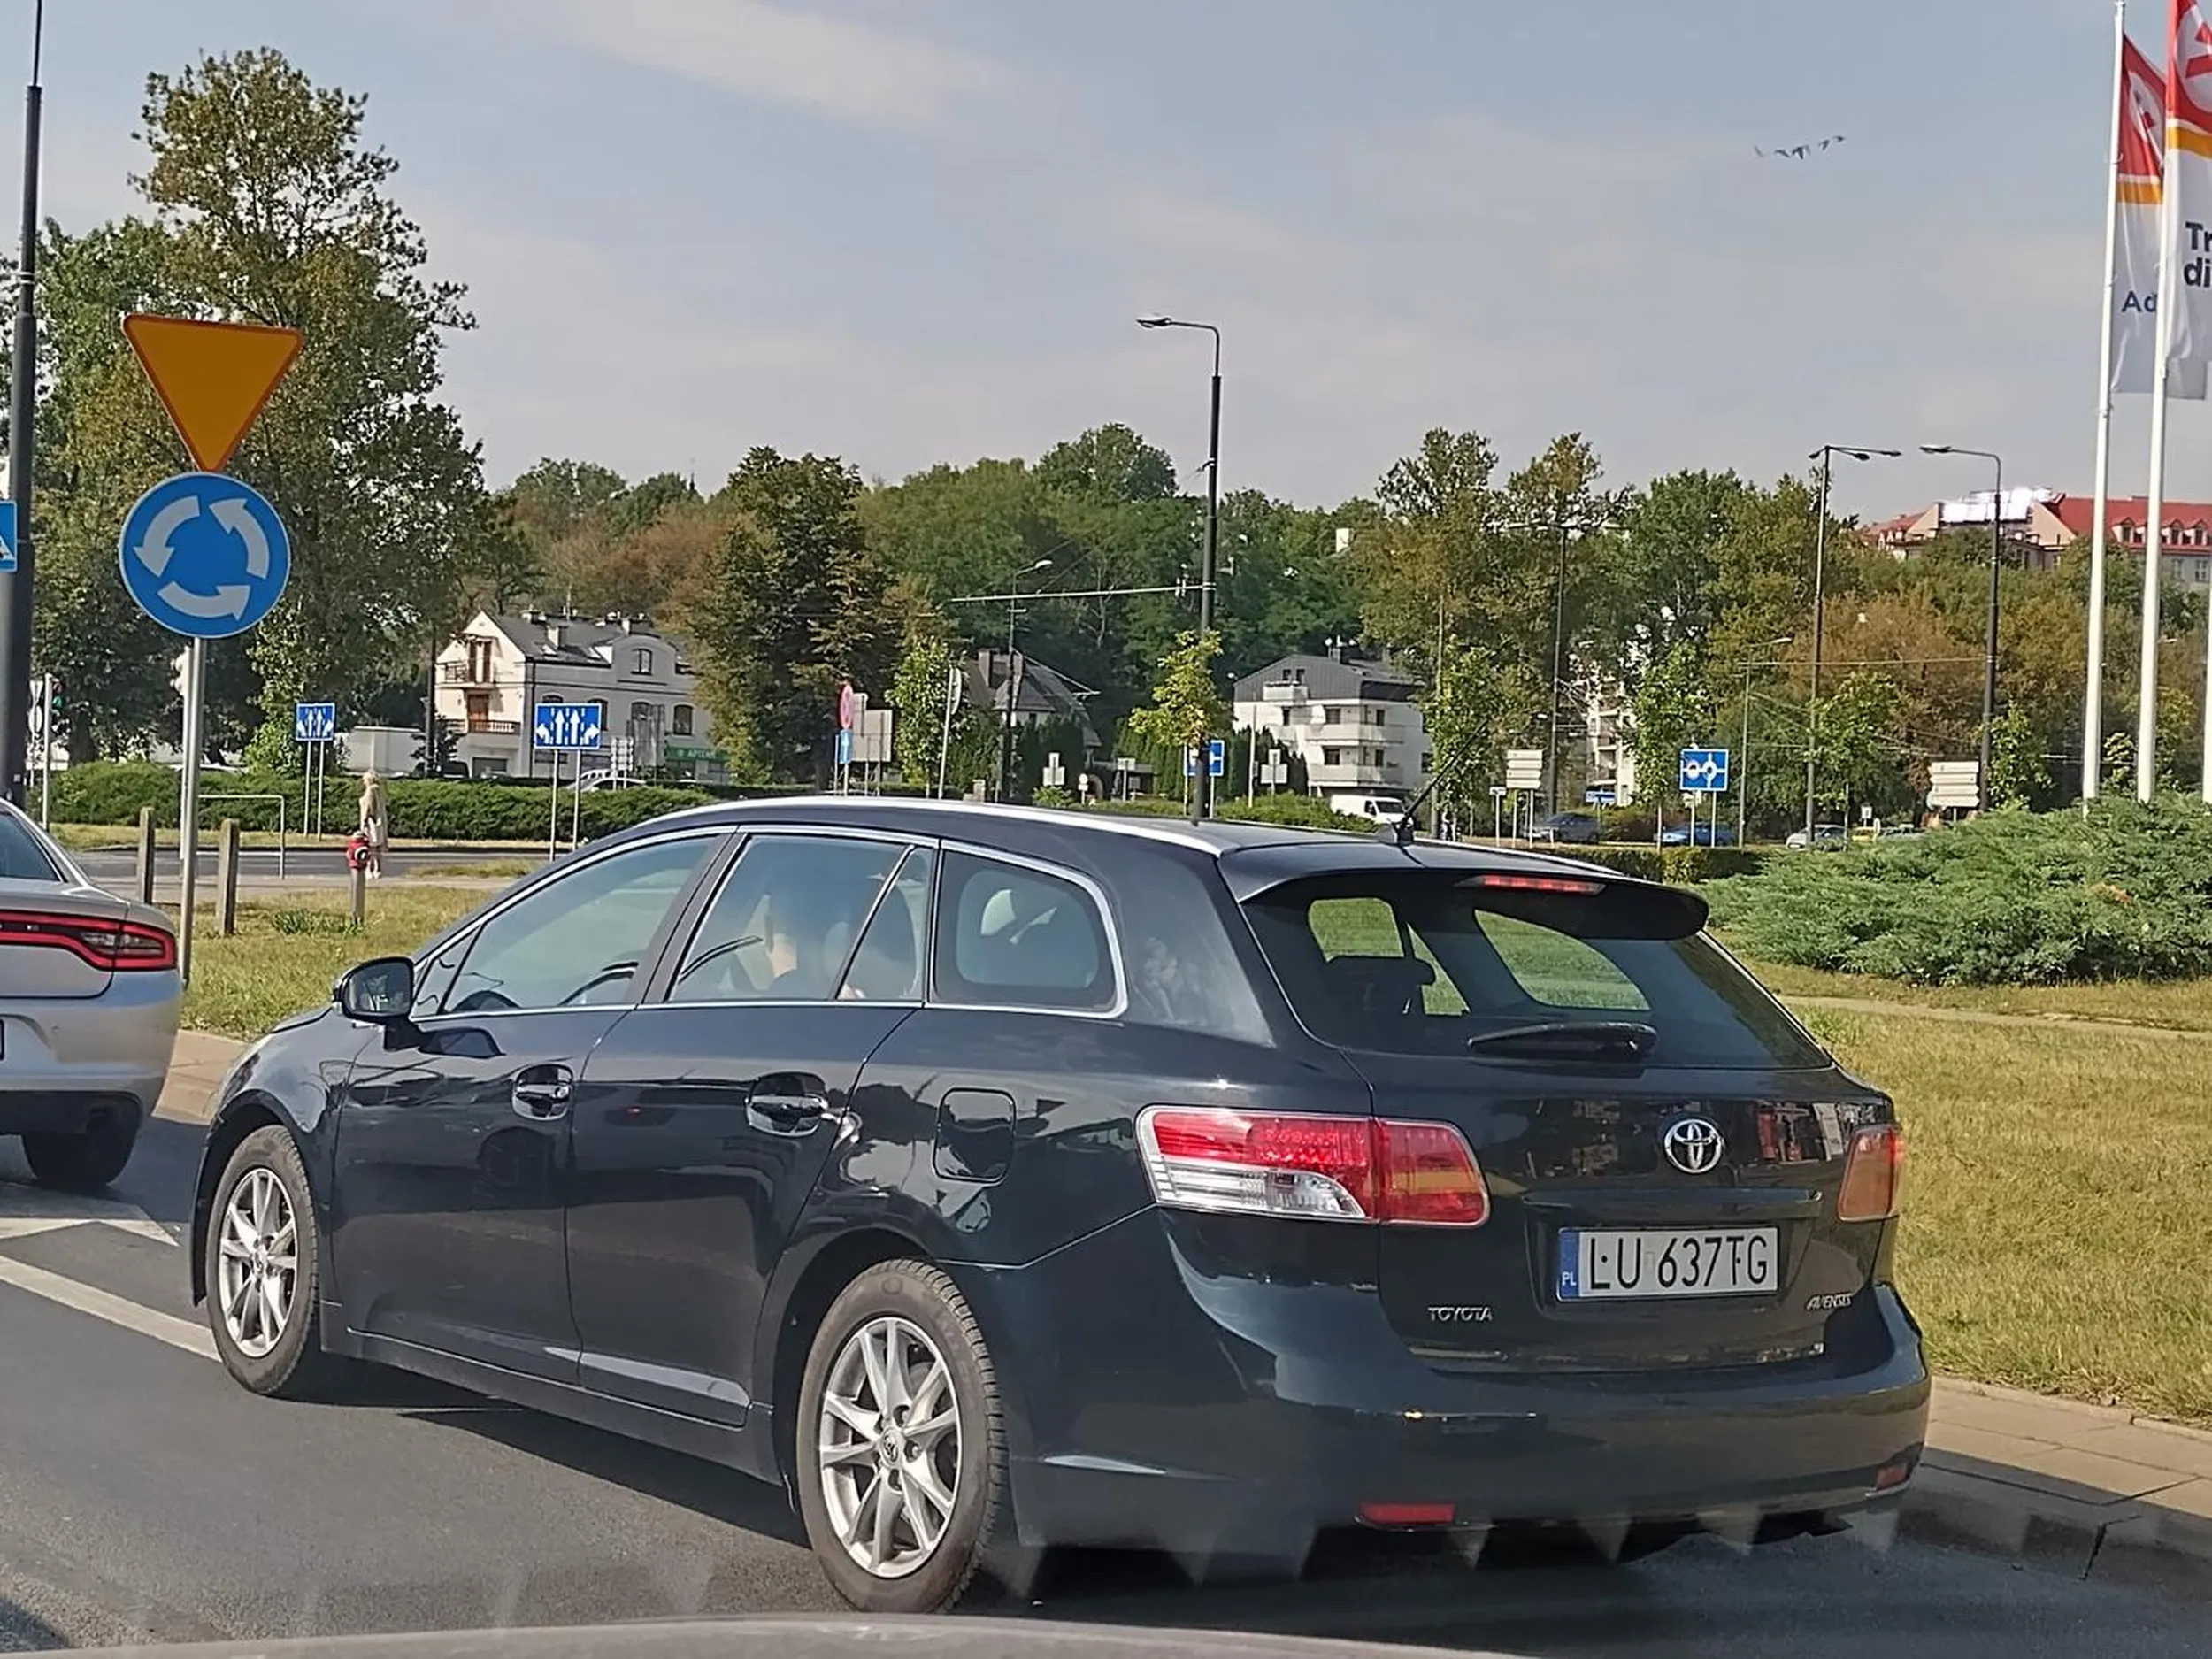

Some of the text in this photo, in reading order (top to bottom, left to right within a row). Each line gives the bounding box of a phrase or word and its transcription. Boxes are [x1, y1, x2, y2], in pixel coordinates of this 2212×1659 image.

[2183, 257, 2211, 288] di
[1590, 1235, 1768, 1289] LU 637TG
[1562, 1271, 1577, 1286] PL
[1427, 1306, 1493, 1321] TOYOTA
